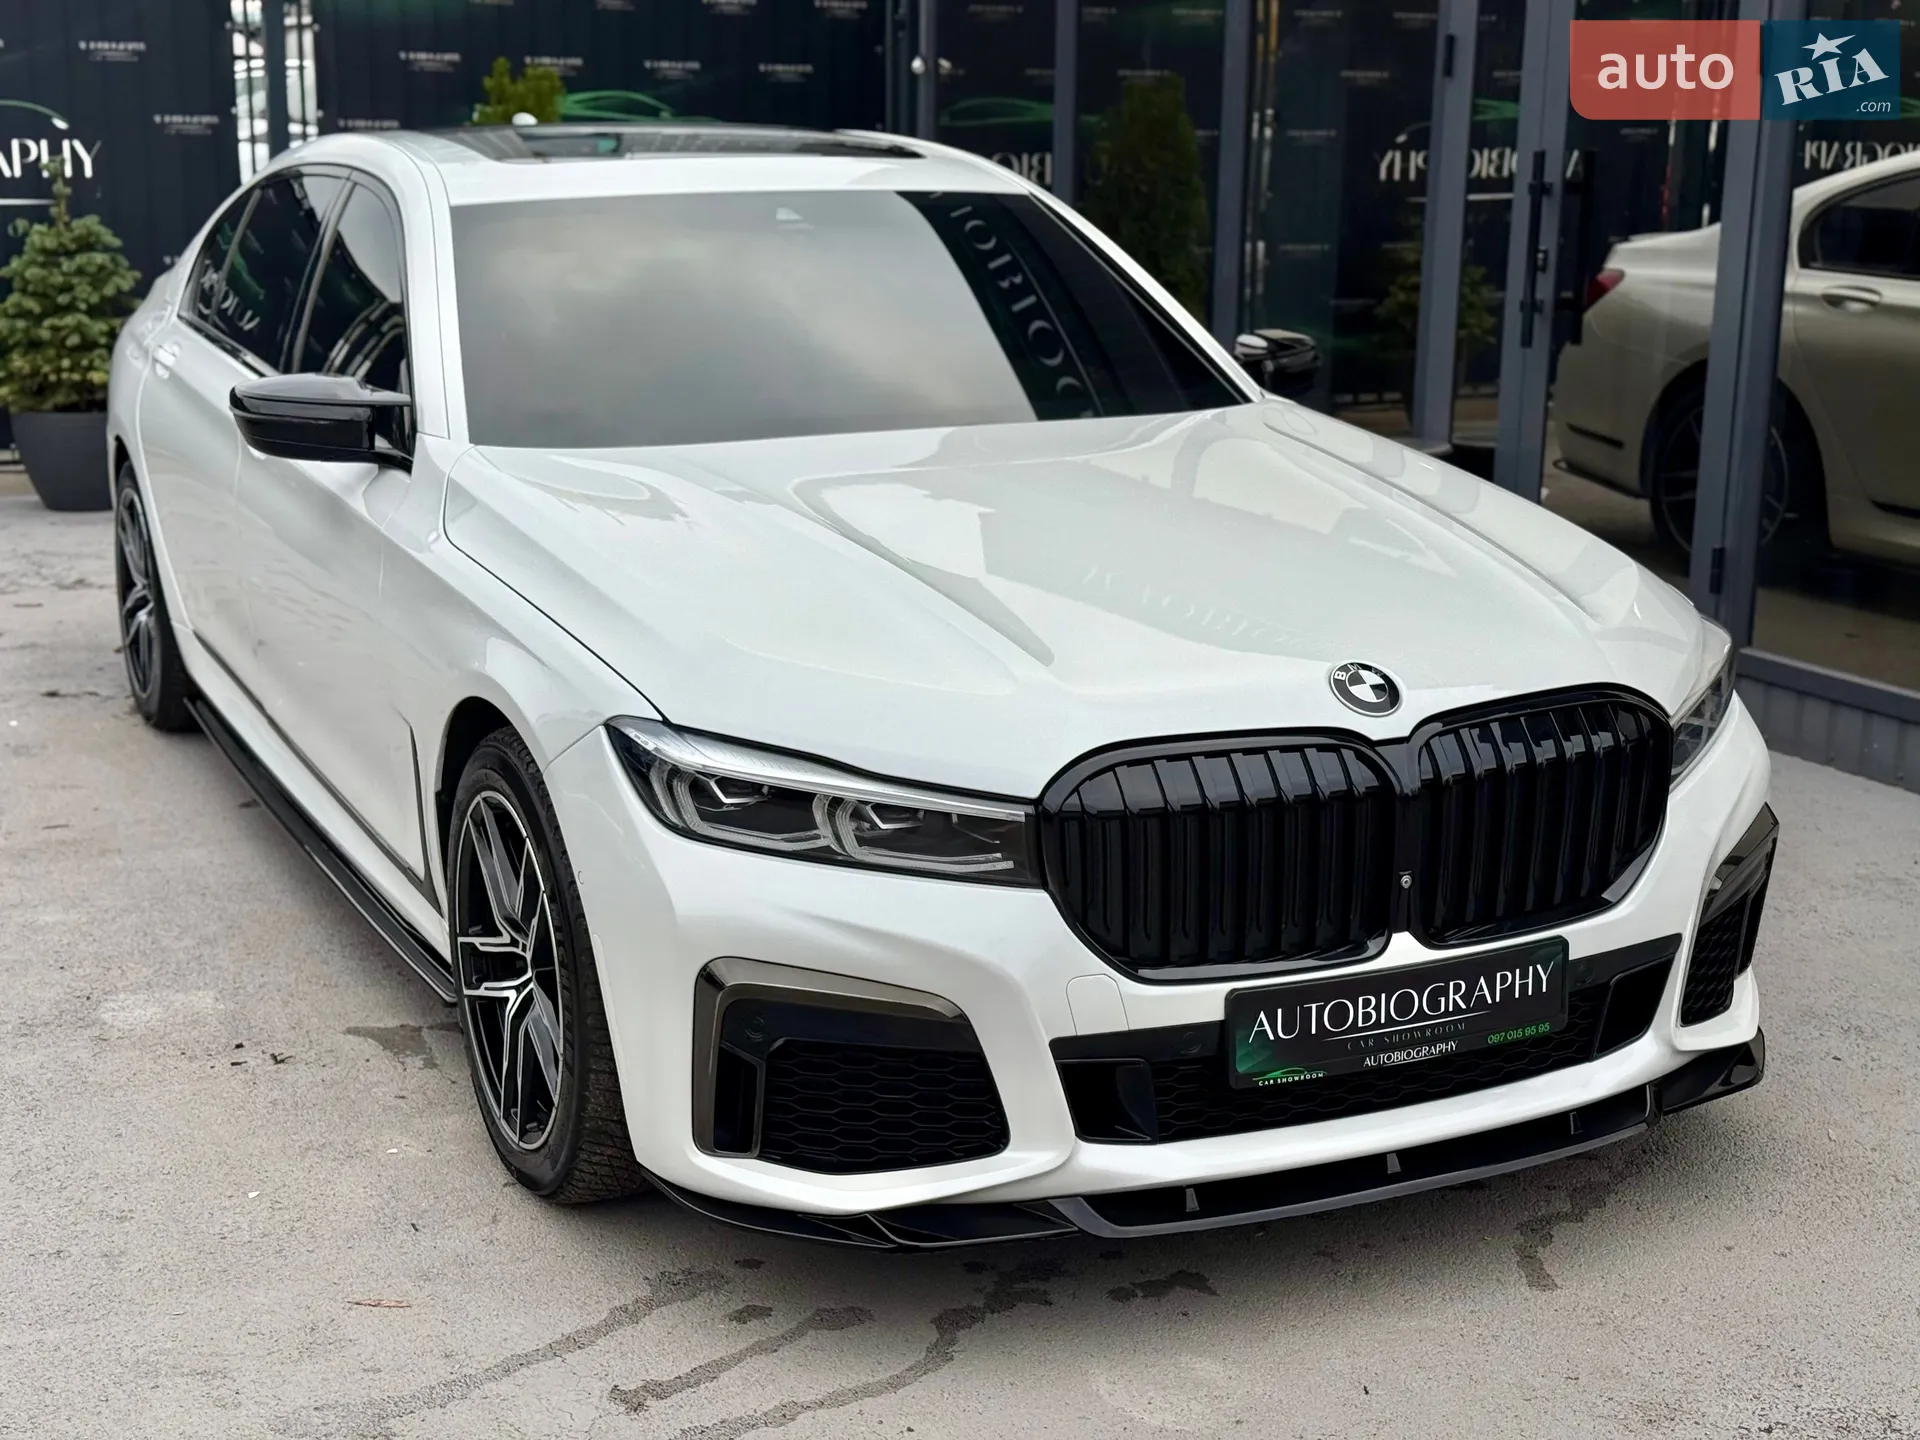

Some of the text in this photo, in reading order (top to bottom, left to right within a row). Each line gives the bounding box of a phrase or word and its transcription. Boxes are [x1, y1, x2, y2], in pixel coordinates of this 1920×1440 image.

[1248, 961, 1554, 1044] AUTOBIOGRAPHY
[1347, 1021, 1466, 1051] CAR SHOWROOM
[1363, 1040, 1459, 1068] AUTOBIOGRAPHY
[1258, 1072, 1325, 1087] CAR SHOWROOM
